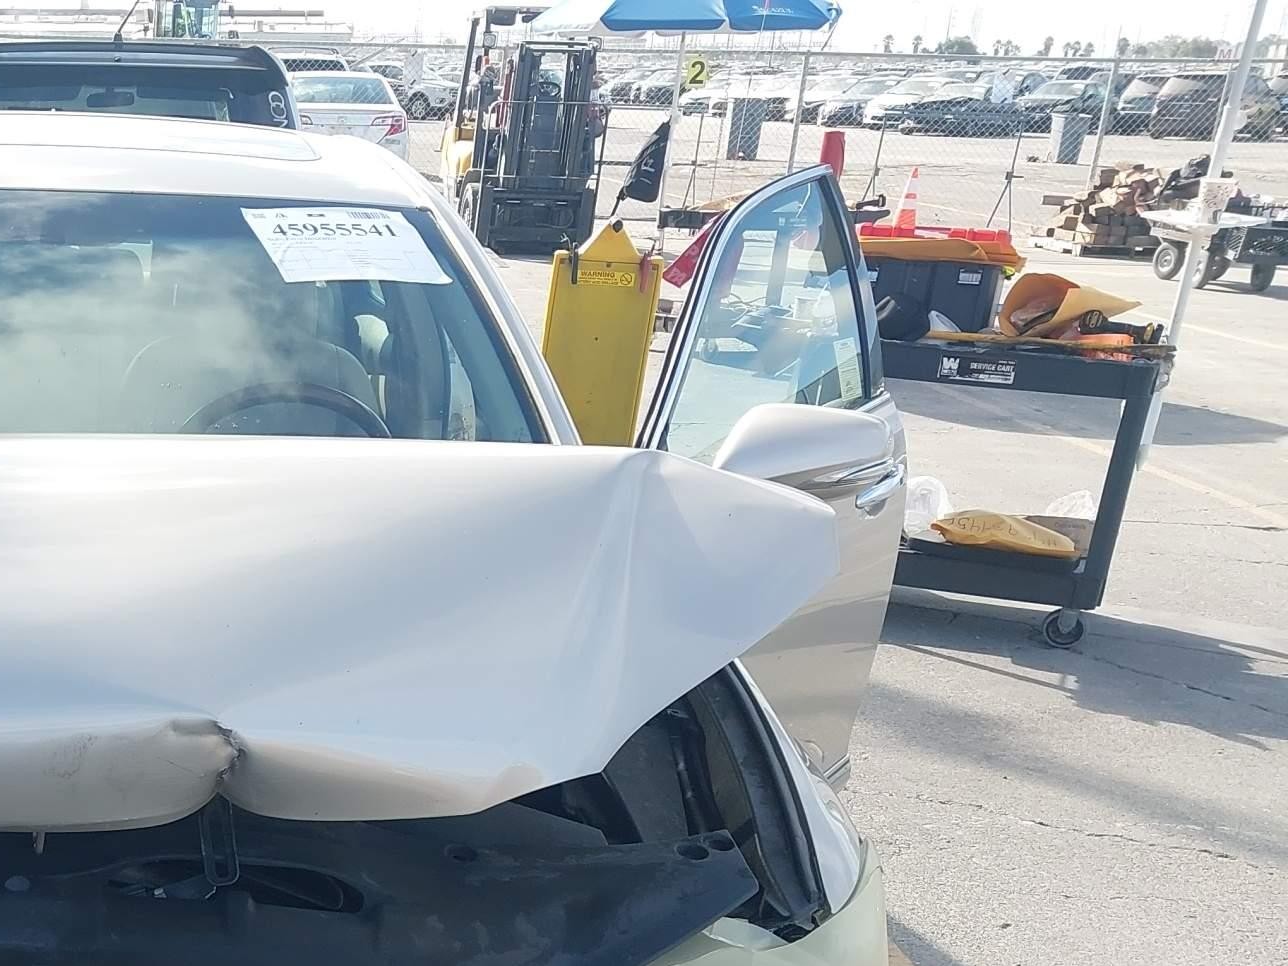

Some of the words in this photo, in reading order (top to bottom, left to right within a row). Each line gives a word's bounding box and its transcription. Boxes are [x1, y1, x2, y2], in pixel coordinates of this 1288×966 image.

[689, 60, 706, 84] 2
[272, 223, 400, 237] 45955541
[970, 362, 996, 371] SERVICE
[997, 364, 1015, 372] CART
